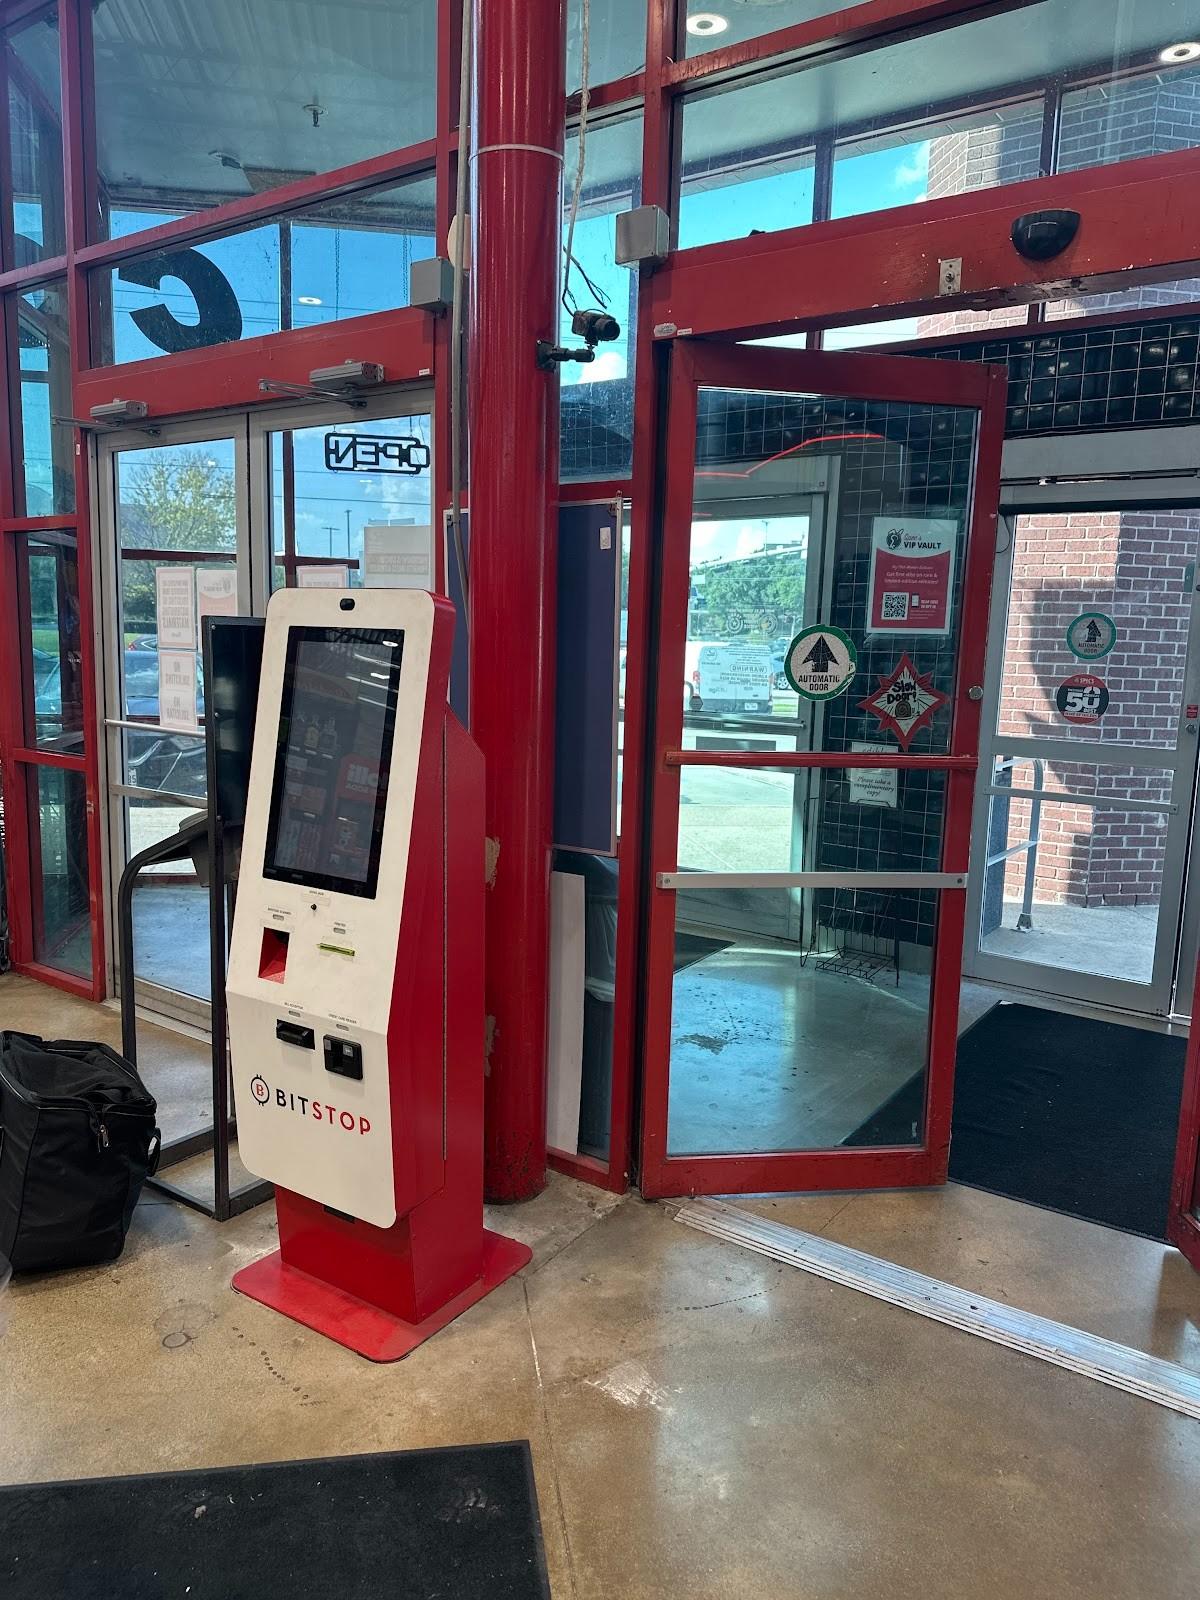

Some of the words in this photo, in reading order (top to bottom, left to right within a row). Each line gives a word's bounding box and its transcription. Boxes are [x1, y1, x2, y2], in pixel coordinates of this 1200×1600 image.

[904, 541, 917, 549] VIP
[798, 674, 840, 683] AUTOMATIC
[809, 683, 829, 691] DOOR
[891, 680, 917, 693] Slow
[276, 1088, 371, 1135] BITSTOP
